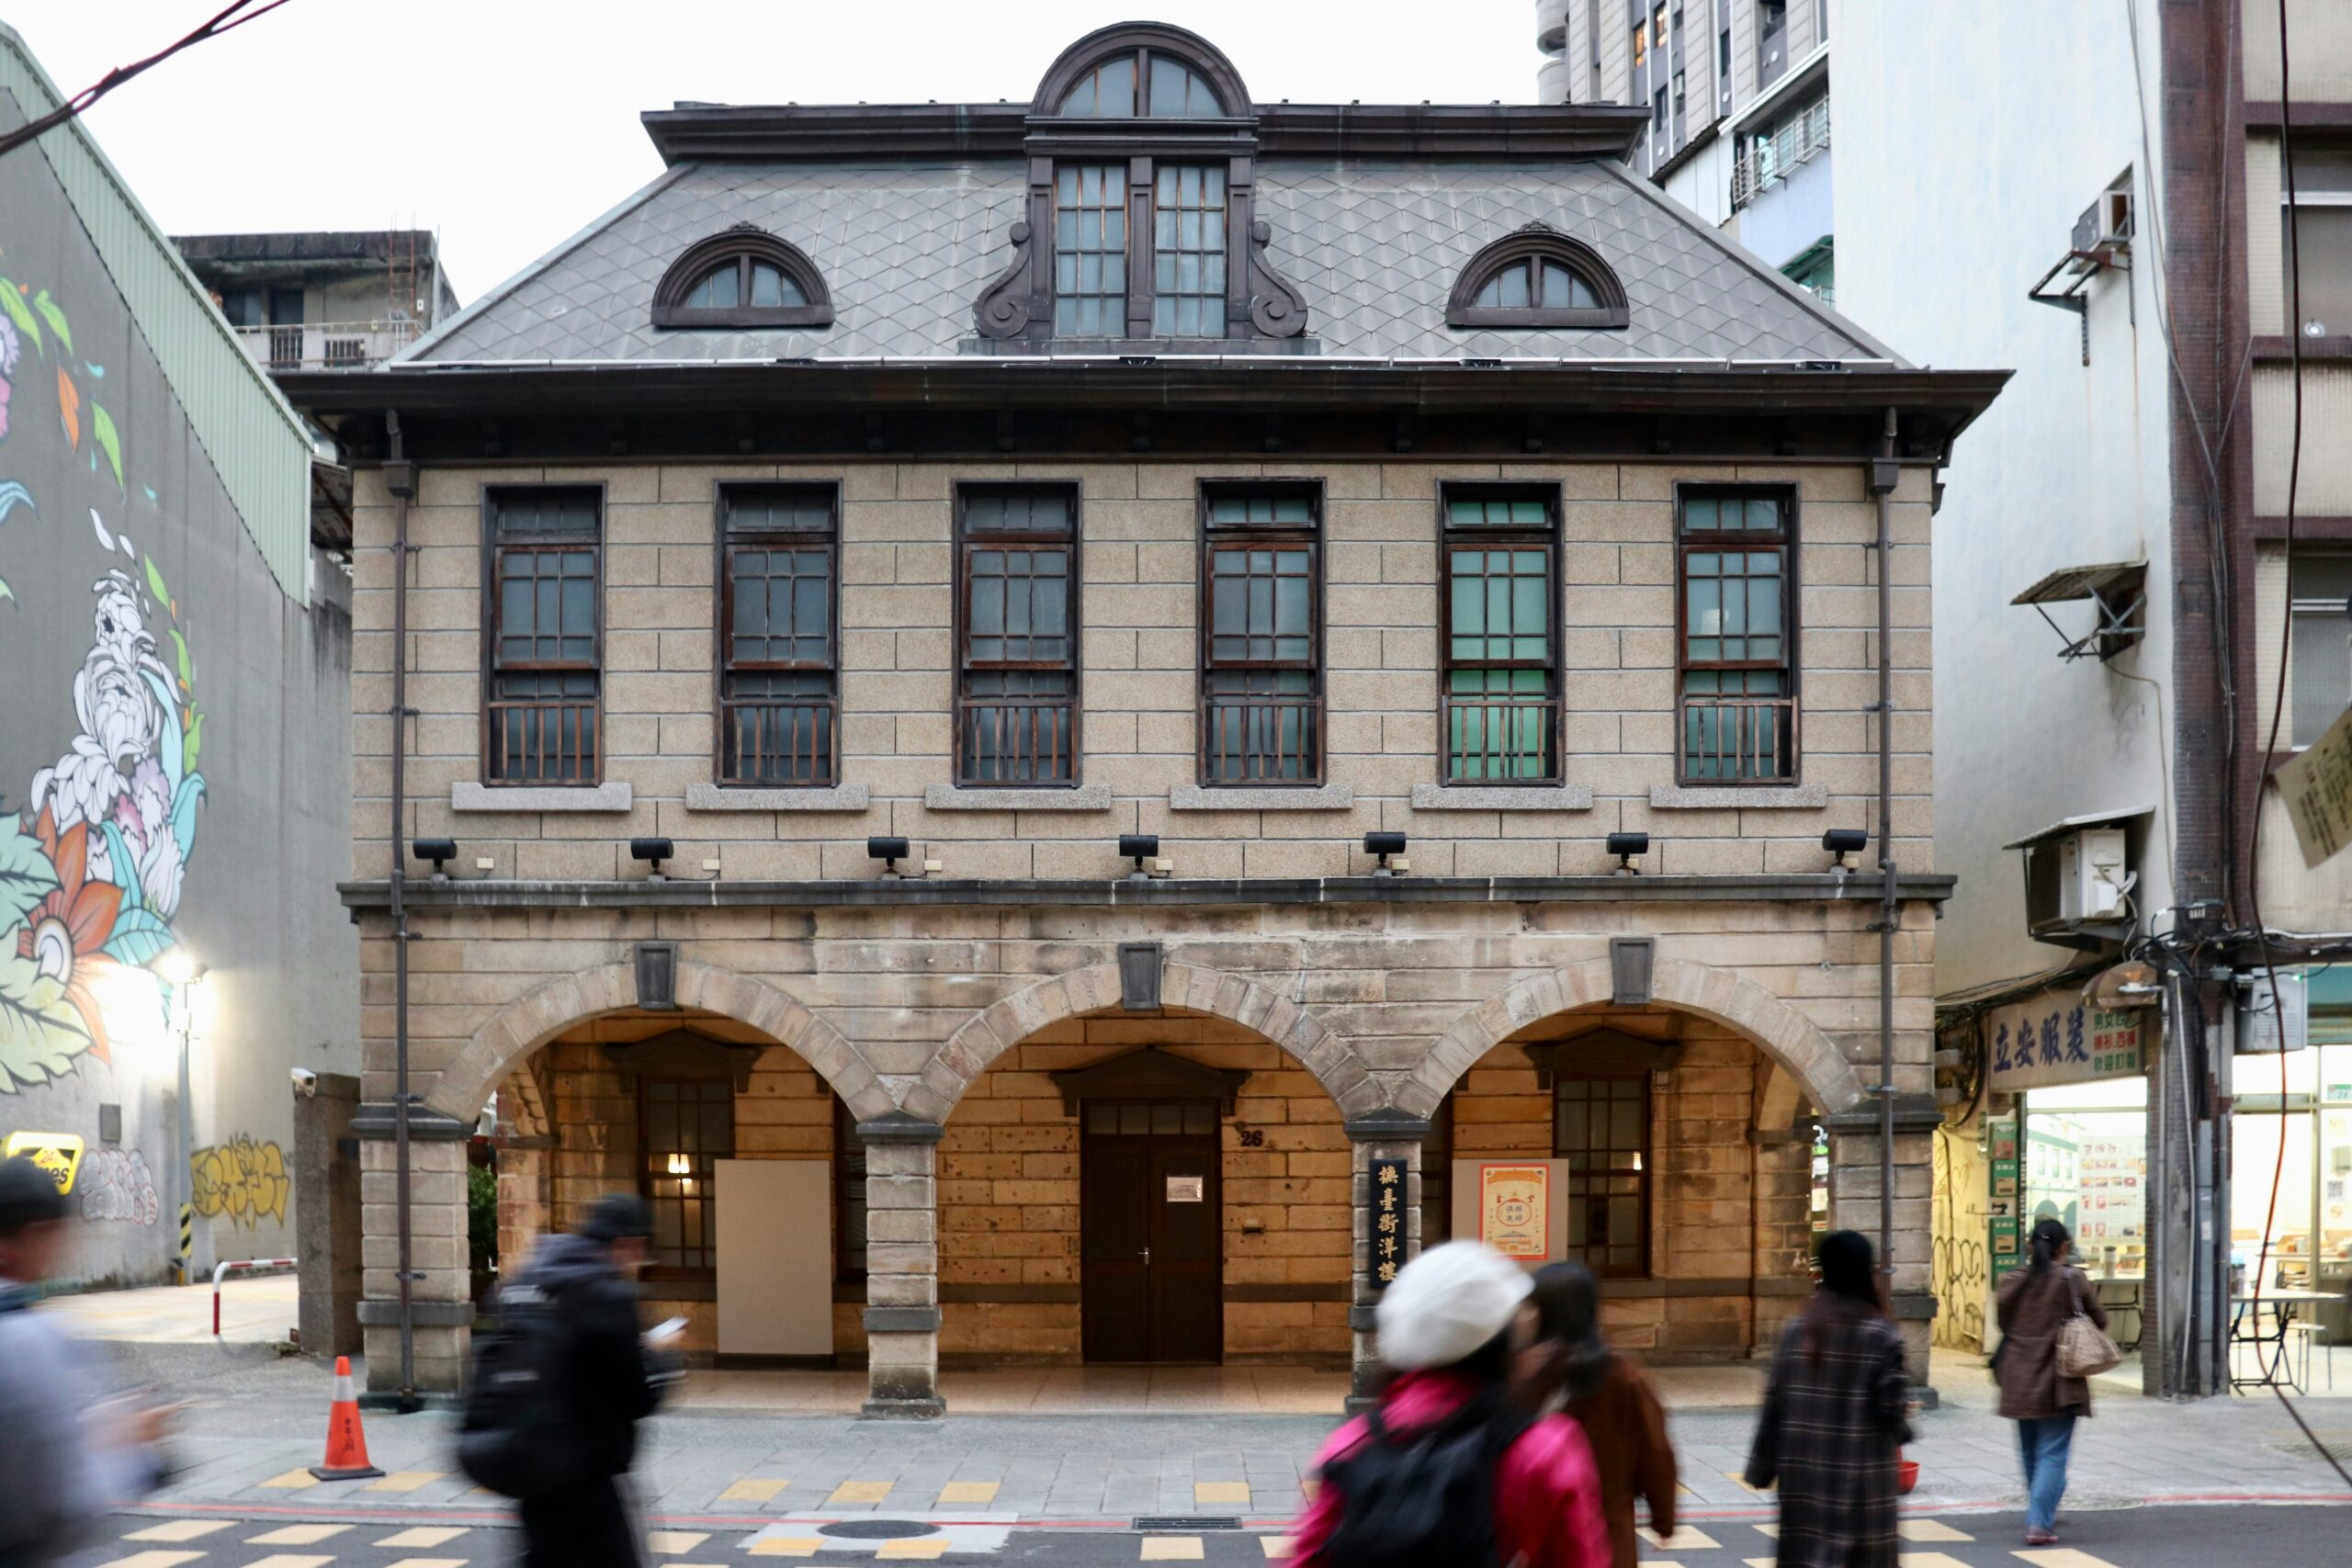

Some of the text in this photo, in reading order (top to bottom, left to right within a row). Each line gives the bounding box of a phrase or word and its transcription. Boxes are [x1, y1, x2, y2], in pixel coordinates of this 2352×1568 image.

[1993, 1004, 2089, 1073] 立安服裝
[1241, 1130, 1263, 1147] 26
[1378, 1165, 1399, 1282] 撫臺街洋樓
